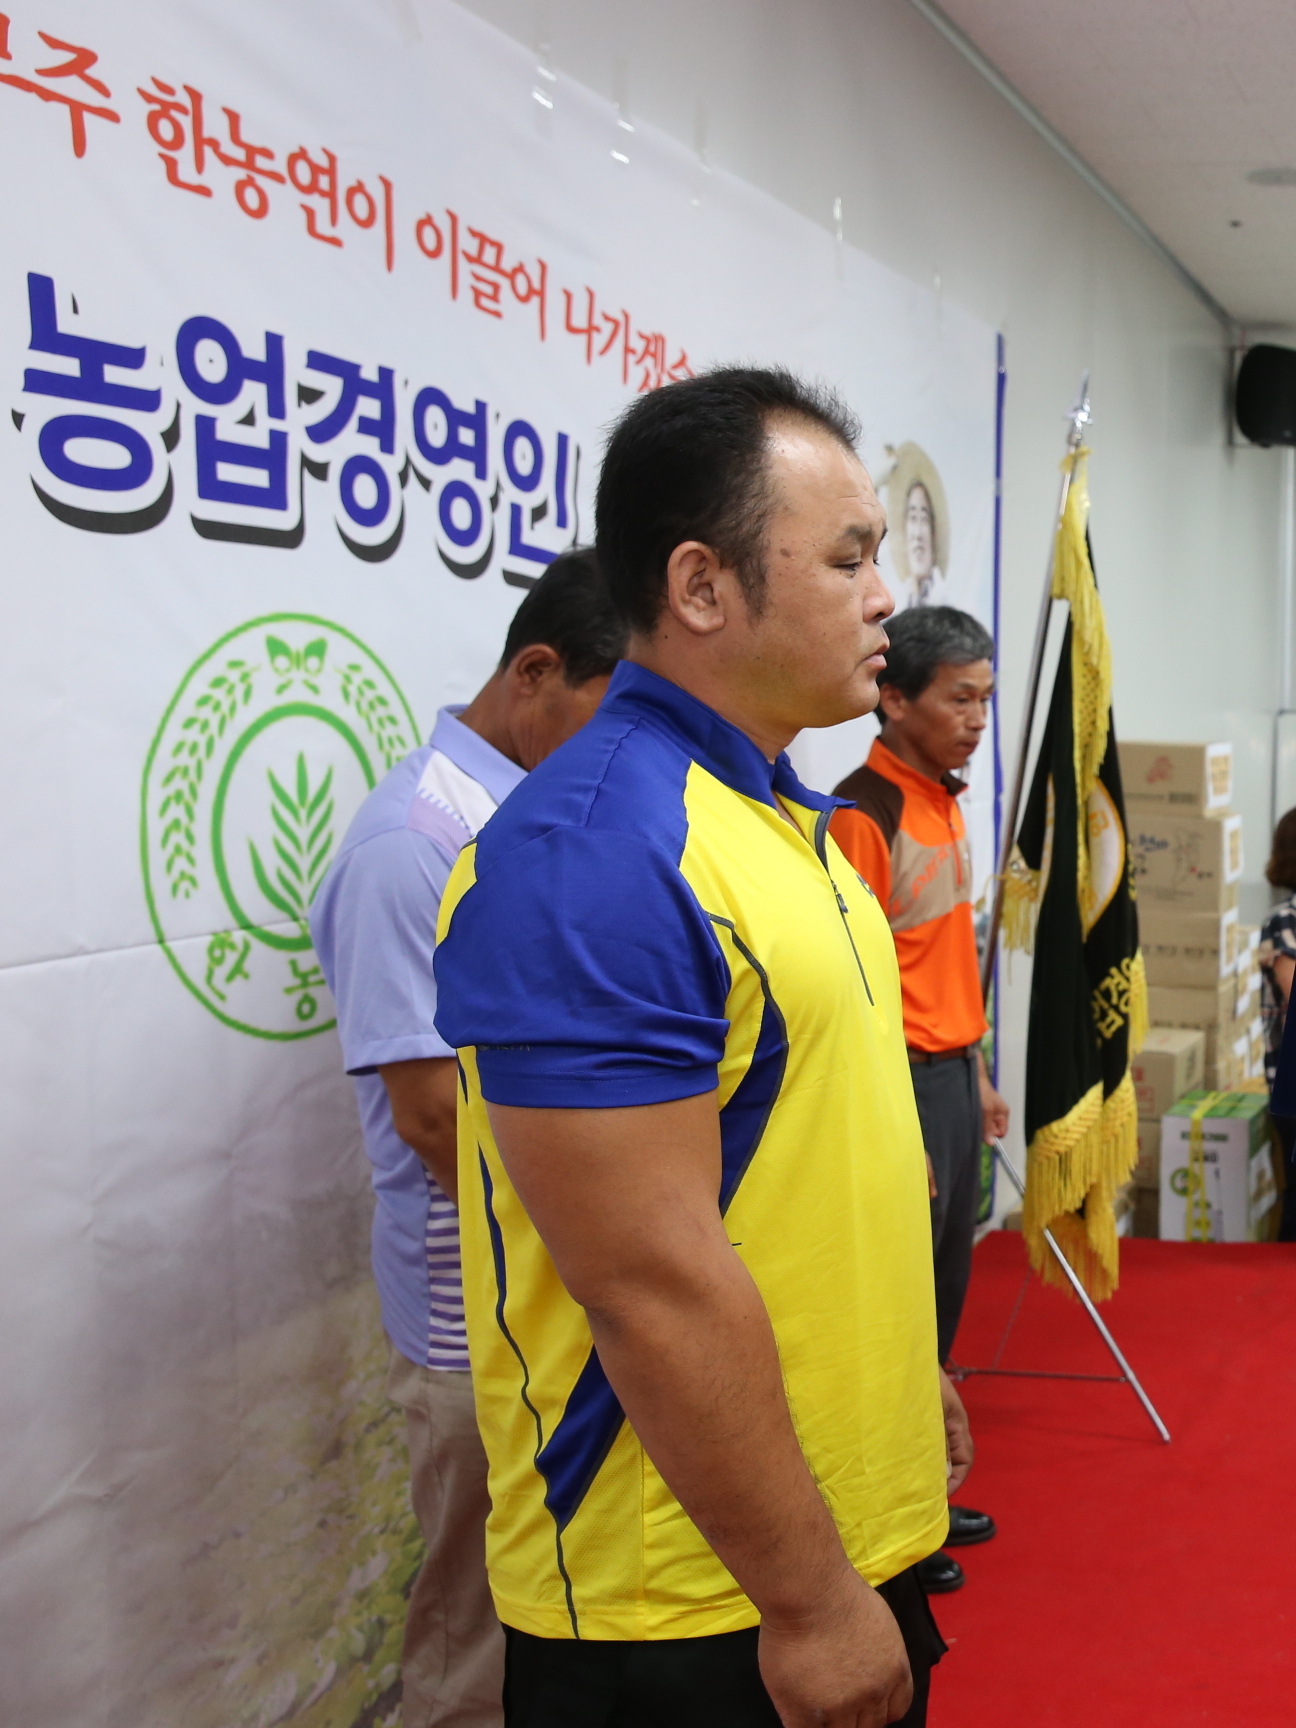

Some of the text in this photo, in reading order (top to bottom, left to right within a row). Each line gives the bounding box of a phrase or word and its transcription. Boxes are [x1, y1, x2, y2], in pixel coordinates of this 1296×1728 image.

[0, 12, 121, 159] 주
[137, 76, 394, 272] 한농연이
[416, 209, 548, 341] 이끌어
[22, 272, 570, 566] 농업경영인
